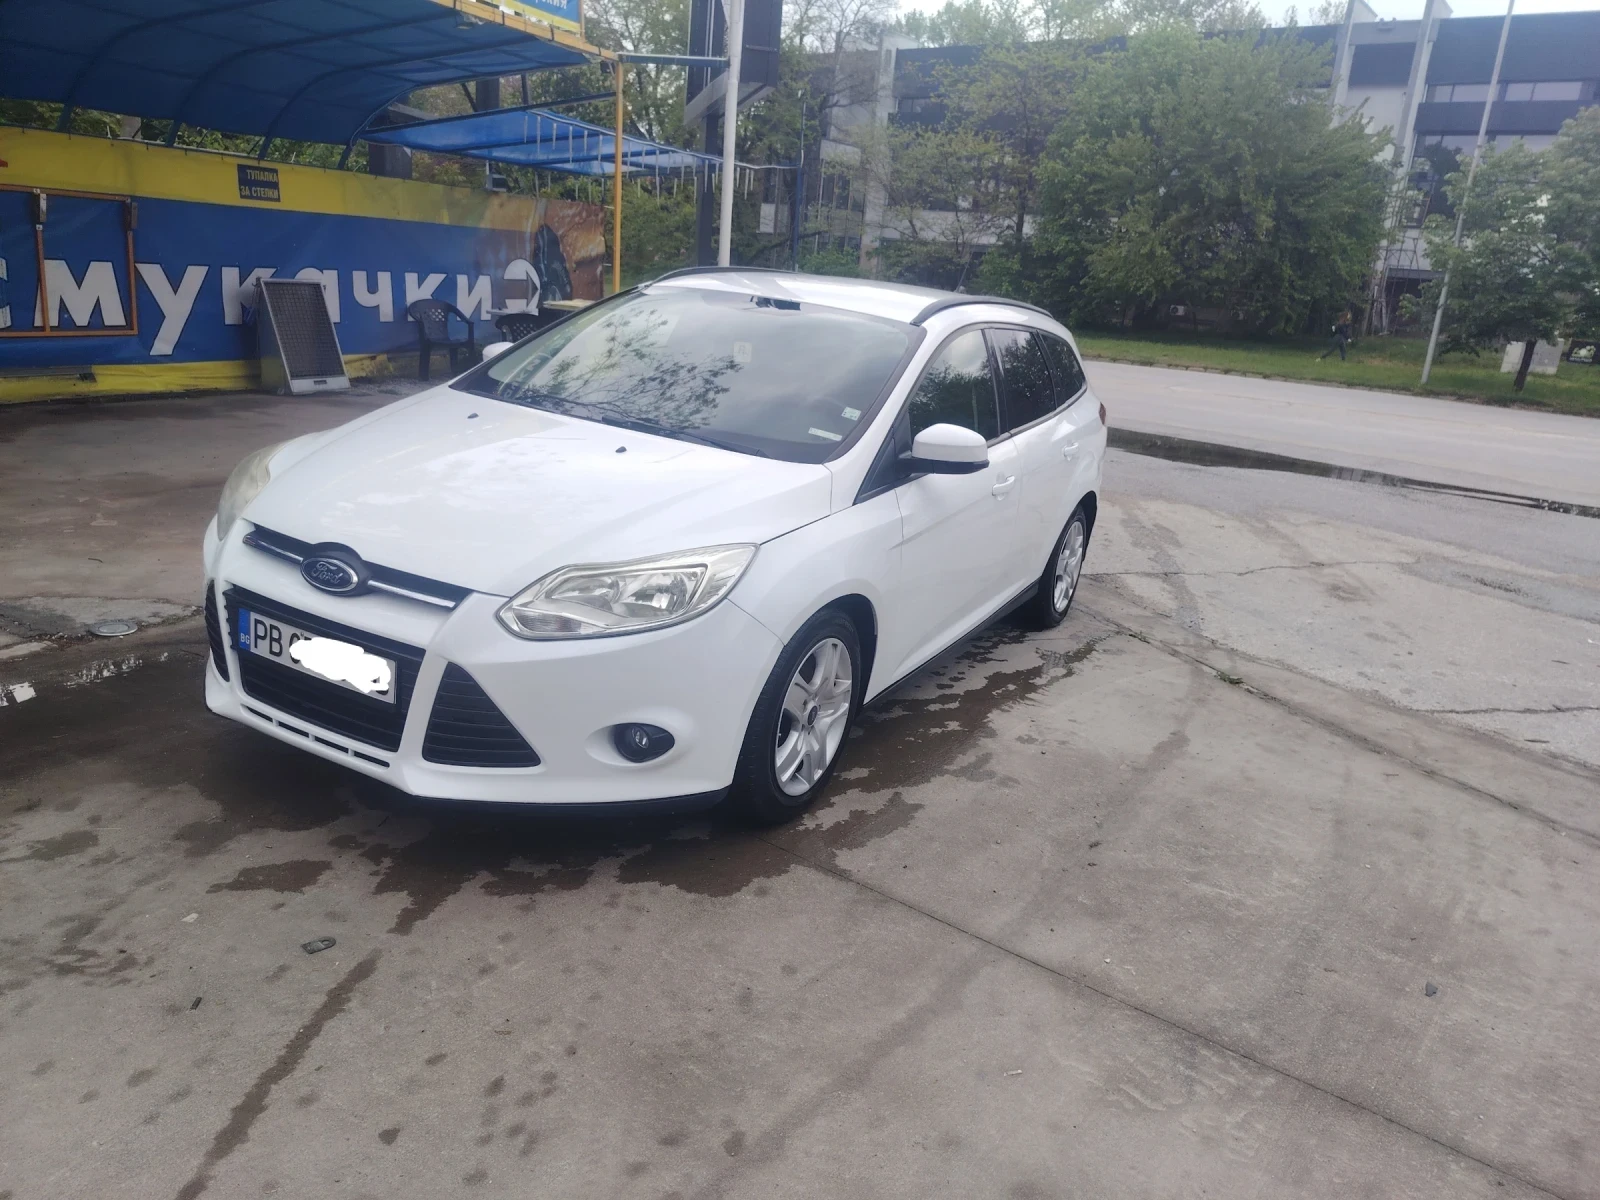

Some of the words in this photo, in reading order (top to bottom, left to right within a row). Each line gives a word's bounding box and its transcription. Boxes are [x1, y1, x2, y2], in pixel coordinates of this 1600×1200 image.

[246, 169, 278, 182] ТУПАЛКА
[240, 185, 251, 197] ЗА
[251, 186, 279, 199] СТЕЛКИ
[0, 257, 493, 356] мукчки
[311, 561, 344, 584] Ford
[240, 632, 250, 645] BG
[254, 617, 283, 657] PB
